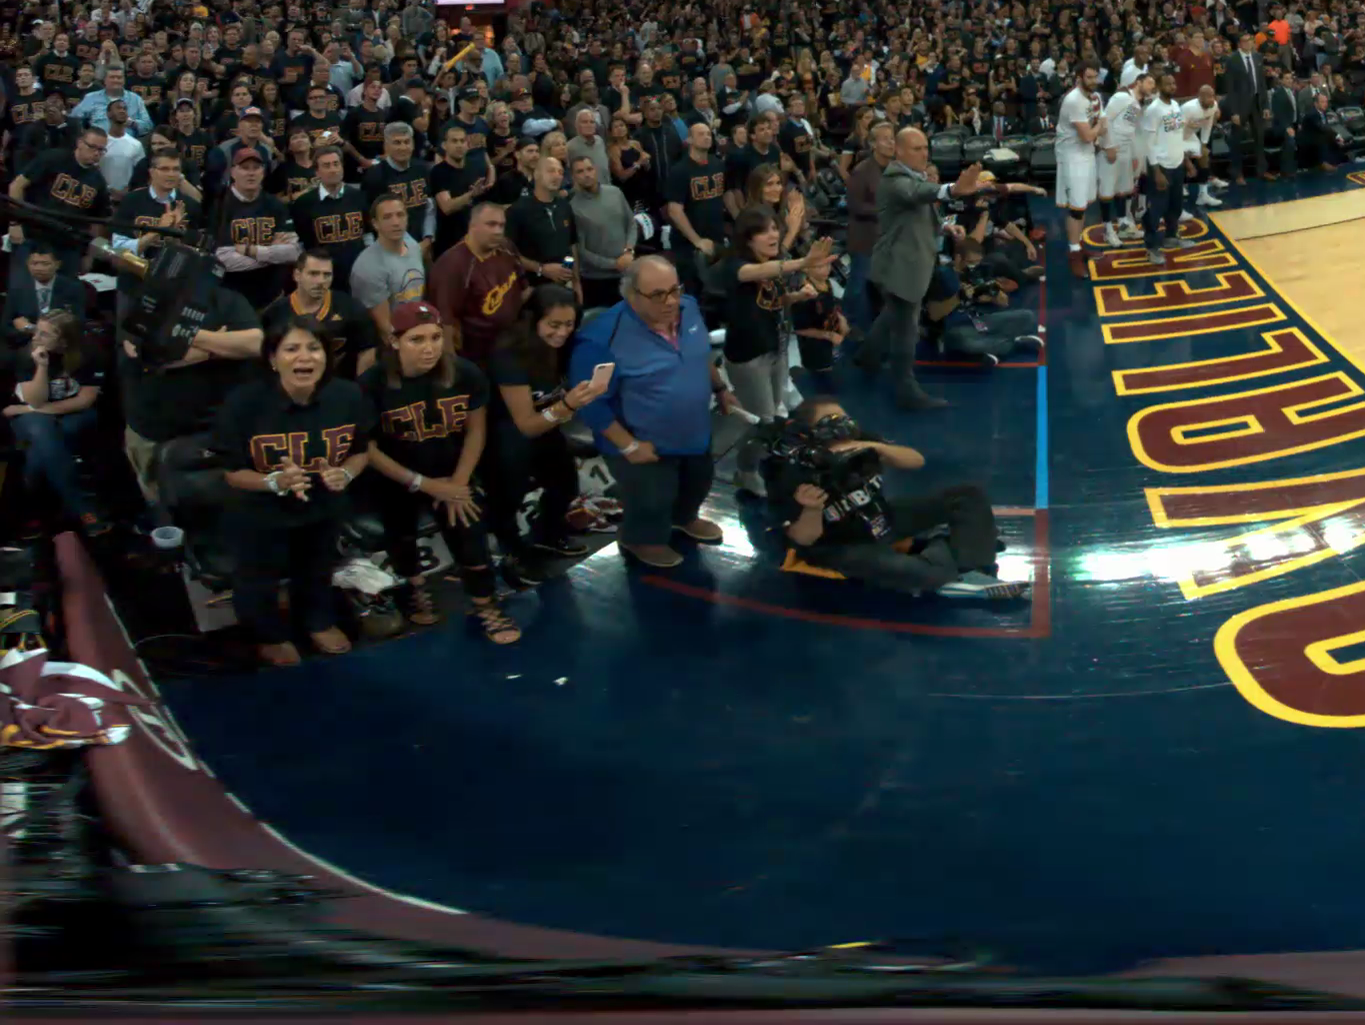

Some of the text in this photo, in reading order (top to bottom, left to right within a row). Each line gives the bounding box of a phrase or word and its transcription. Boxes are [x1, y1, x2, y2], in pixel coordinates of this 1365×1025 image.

[50, 173, 97, 209] CLE
[315, 210, 364, 245] CLE
[381, 394, 471, 443] CLE
[250, 423, 357, 473] CLE
